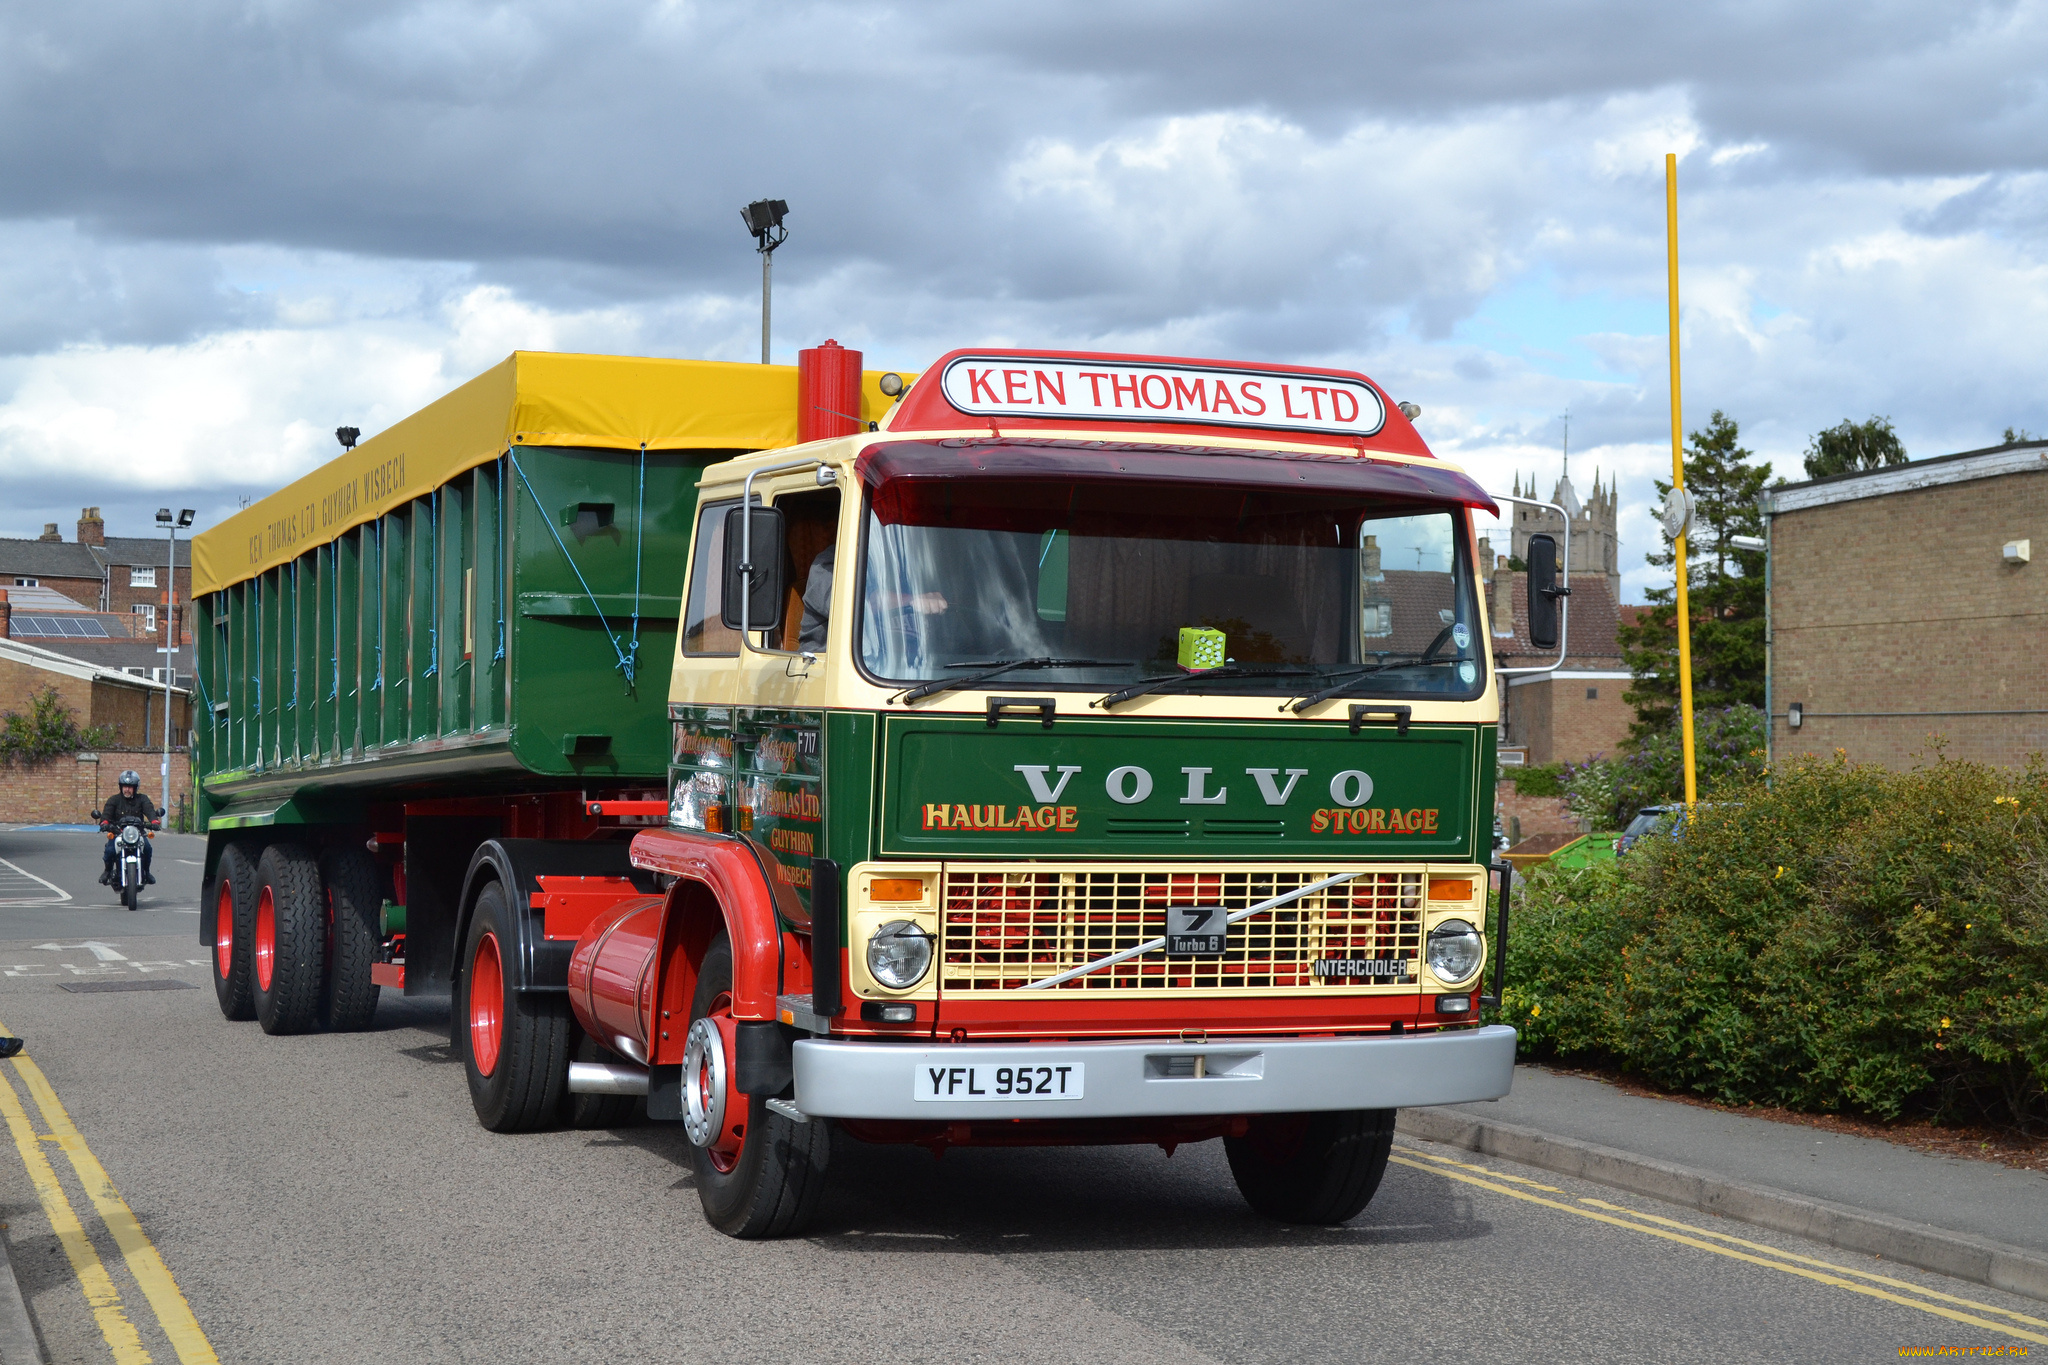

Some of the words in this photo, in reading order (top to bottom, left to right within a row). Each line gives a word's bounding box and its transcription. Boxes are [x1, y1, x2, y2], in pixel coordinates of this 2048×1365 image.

[967, 368, 1067, 406] KEN
[1078, 371, 1267, 416] THOMAS
[1280, 384, 1360, 423] LTD
[249, 532, 263, 565] KEN
[268, 515, 297, 553] THOMAS
[301, 503, 315, 538] LTD
[322, 478, 358, 528] GUYHIRN
[364, 452, 405, 504] WISBECH
[804, 732, 817, 754] 717
[1014, 765, 1375, 807] VOLVO
[760, 783, 800, 819] THOMAS
[921, 803, 1080, 832] HAULAGE
[1310, 808, 1440, 836] STORAGE
[771, 828, 814, 856] GUYHIRN
[776, 864, 812, 889] WISBECH
[1181, 909, 1214, 932] 7
[1173, 936, 1206, 952] Turbo
[1209, 935, 1219, 952] 6
[1315, 959, 1407, 976] INTERCOOLER
[929, 1067, 986, 1095] YFL
[995, 1066, 1072, 1095] 952T
